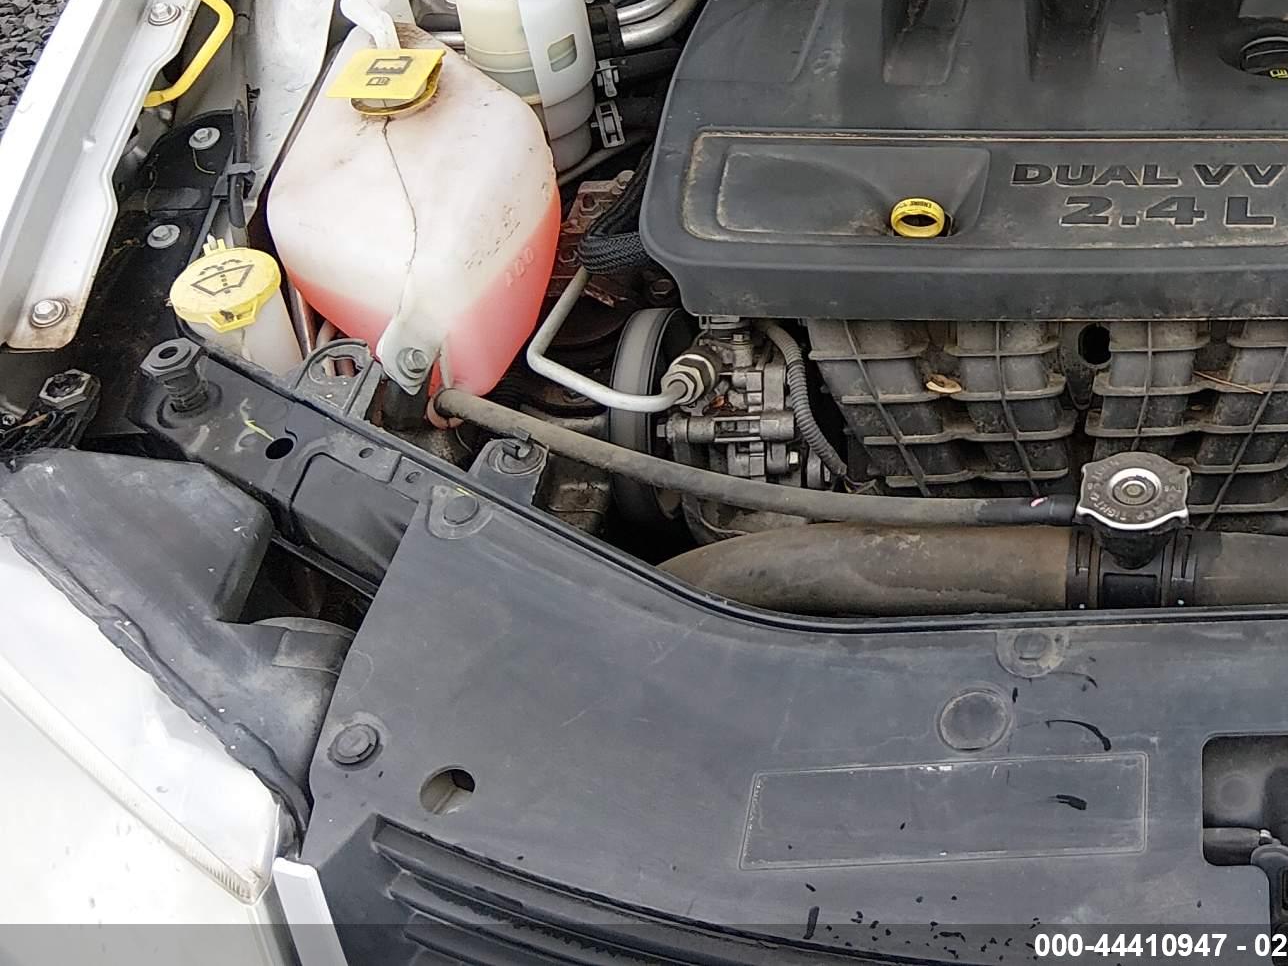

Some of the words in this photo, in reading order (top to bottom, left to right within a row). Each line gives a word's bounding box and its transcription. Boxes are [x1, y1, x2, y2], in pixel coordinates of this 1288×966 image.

[1011, 163, 1182, 186] DUAL
[1059, 195, 1207, 226] 2.4
[1223, 195, 1276, 226] L
